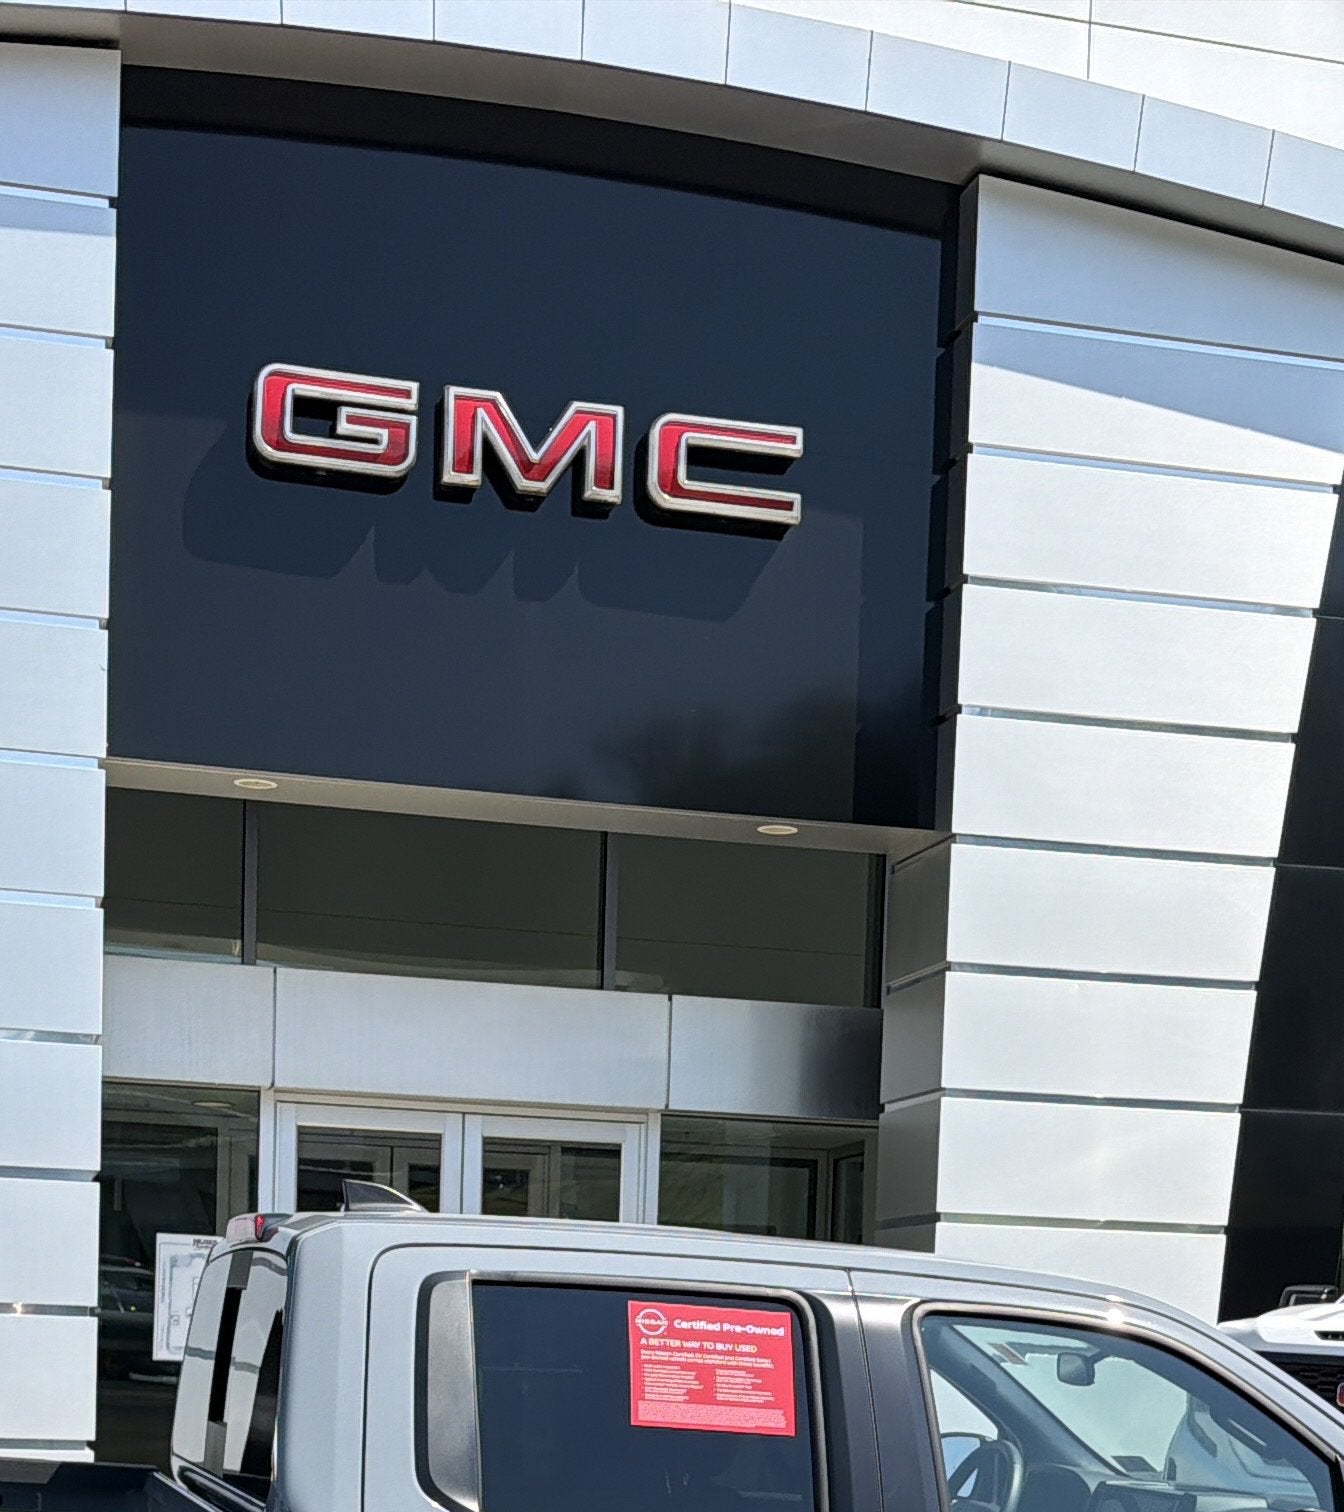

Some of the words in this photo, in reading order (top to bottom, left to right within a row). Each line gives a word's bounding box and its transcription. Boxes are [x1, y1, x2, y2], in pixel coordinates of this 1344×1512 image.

[252, 361, 805, 526] GMC
[673, 1318, 721, 1332] Certified
[722, 1322, 785, 1337] Pre-Owned
[640, 1337, 648, 1345] A
[648, 1338, 681, 1348] BETTER
[682, 1340, 700, 1349] WAY
[702, 1341, 715, 1350] TO
[716, 1343, 734, 1351] BUY
[734, 1344, 758, 1353] USED
